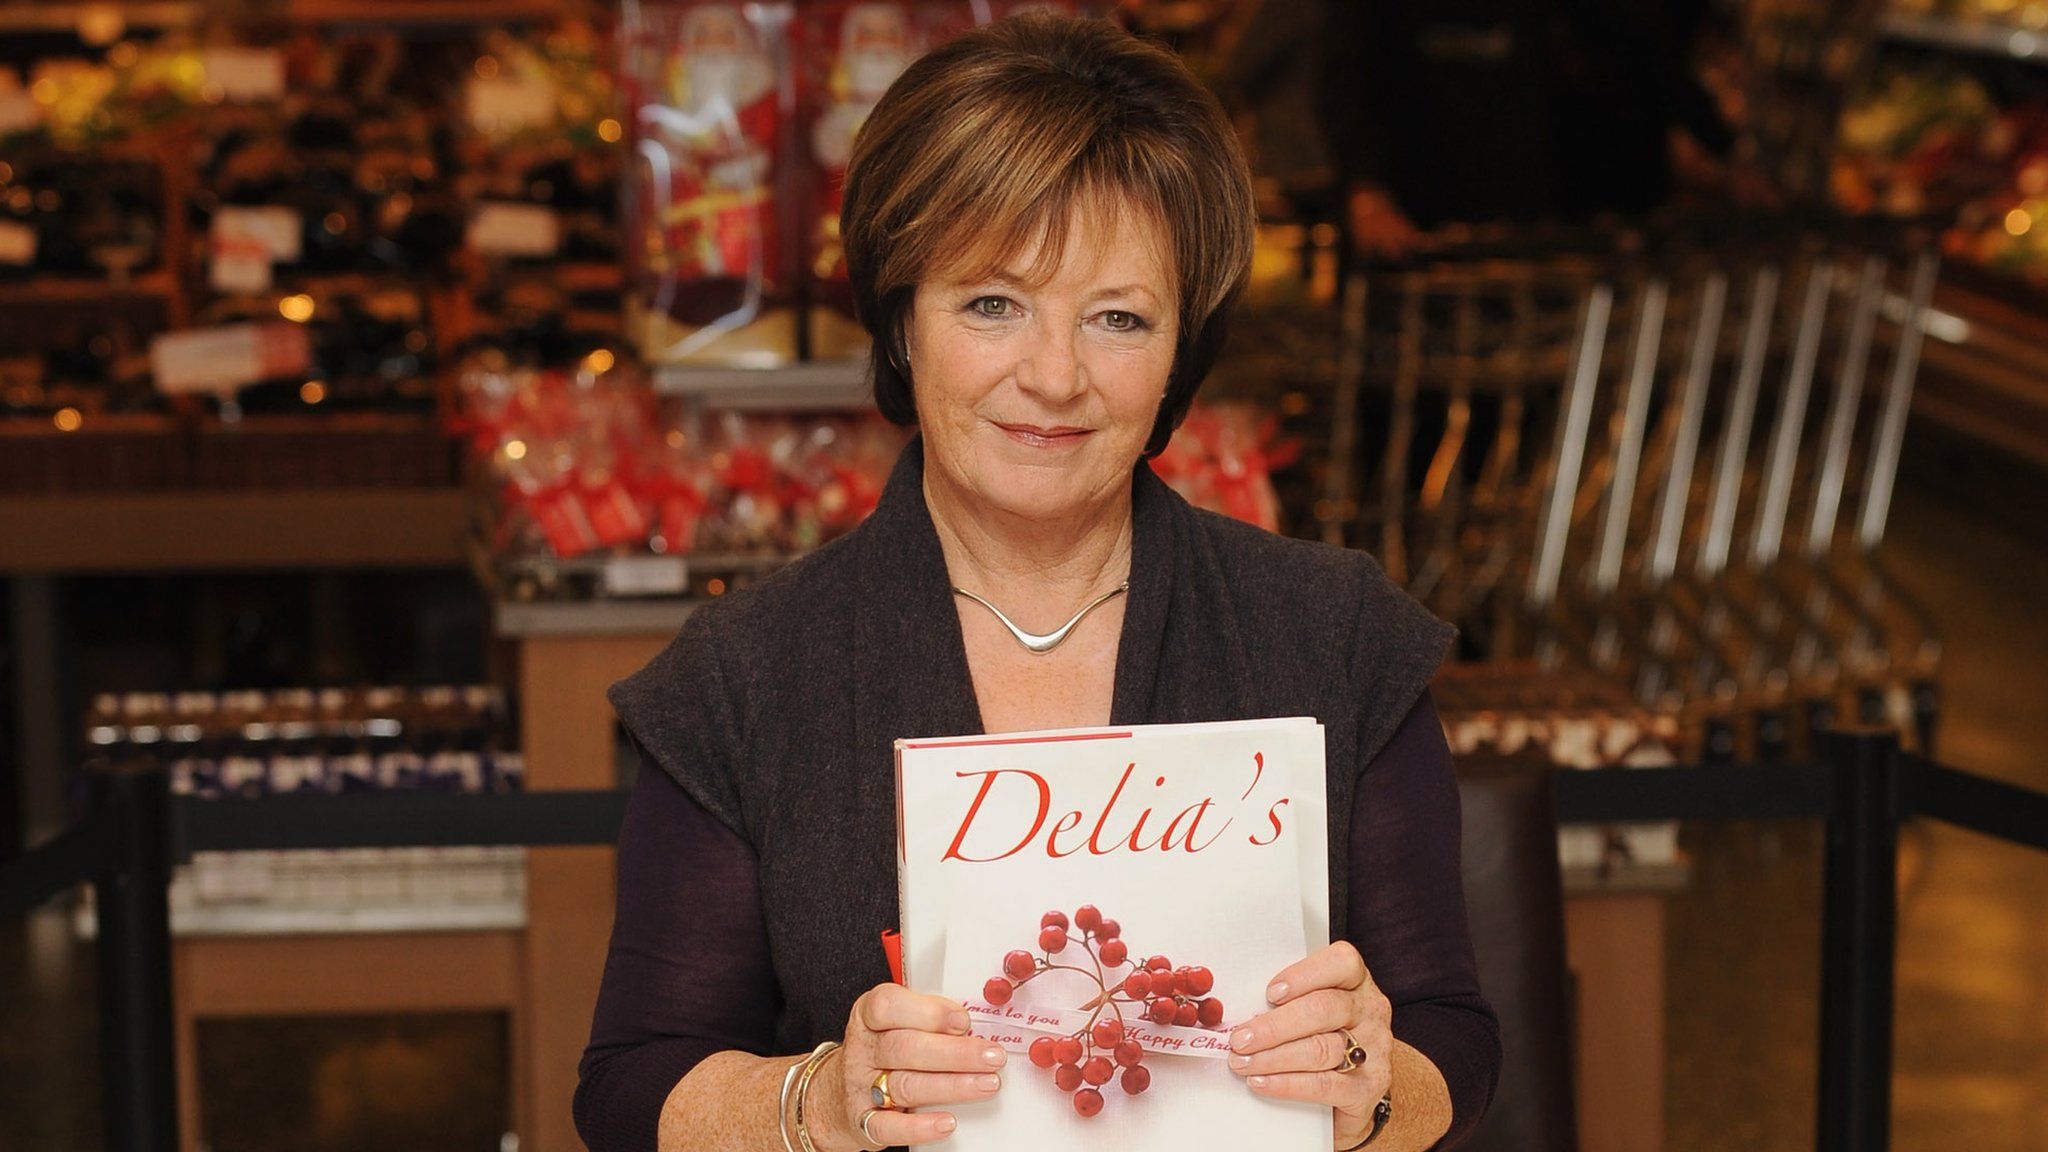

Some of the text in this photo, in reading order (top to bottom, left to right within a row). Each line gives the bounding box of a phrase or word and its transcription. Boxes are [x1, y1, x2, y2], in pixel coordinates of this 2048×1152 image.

[940, 751, 1290, 863] Delia's
[1005, 1007, 1023, 1019] to
[1026, 1014, 1060, 1025] you
[1123, 1025, 1185, 1050] Happy
